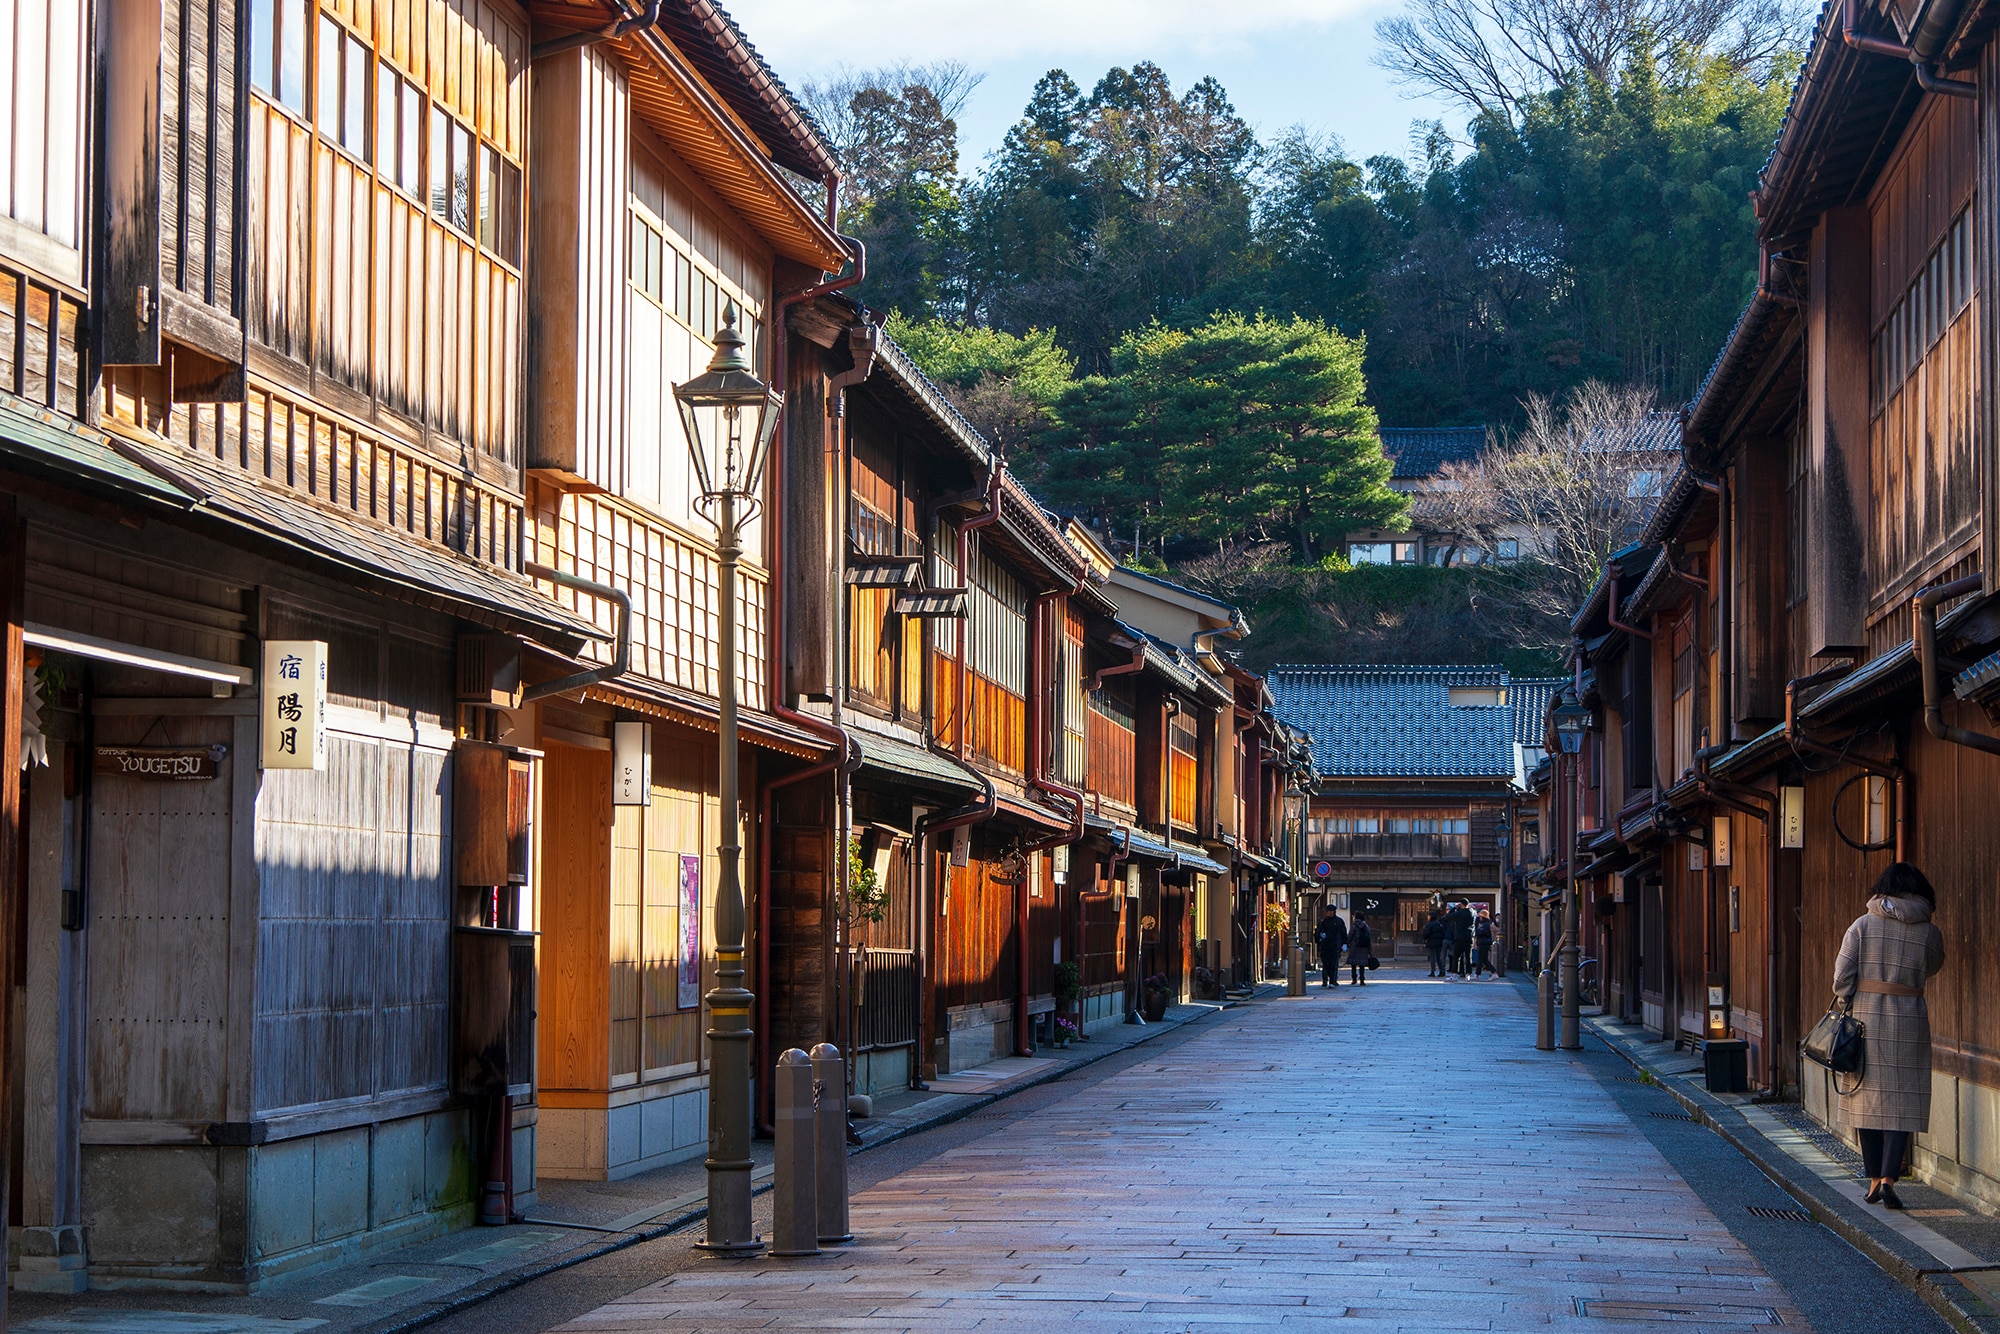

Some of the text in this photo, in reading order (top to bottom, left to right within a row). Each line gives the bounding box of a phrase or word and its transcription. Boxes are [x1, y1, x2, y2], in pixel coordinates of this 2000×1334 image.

[277, 654, 304, 755] 宿陽月
[117, 756, 201, 775] YOUGETSU
[624, 767, 633, 797] ひがし
[1790, 816, 1798, 843] ひがし
